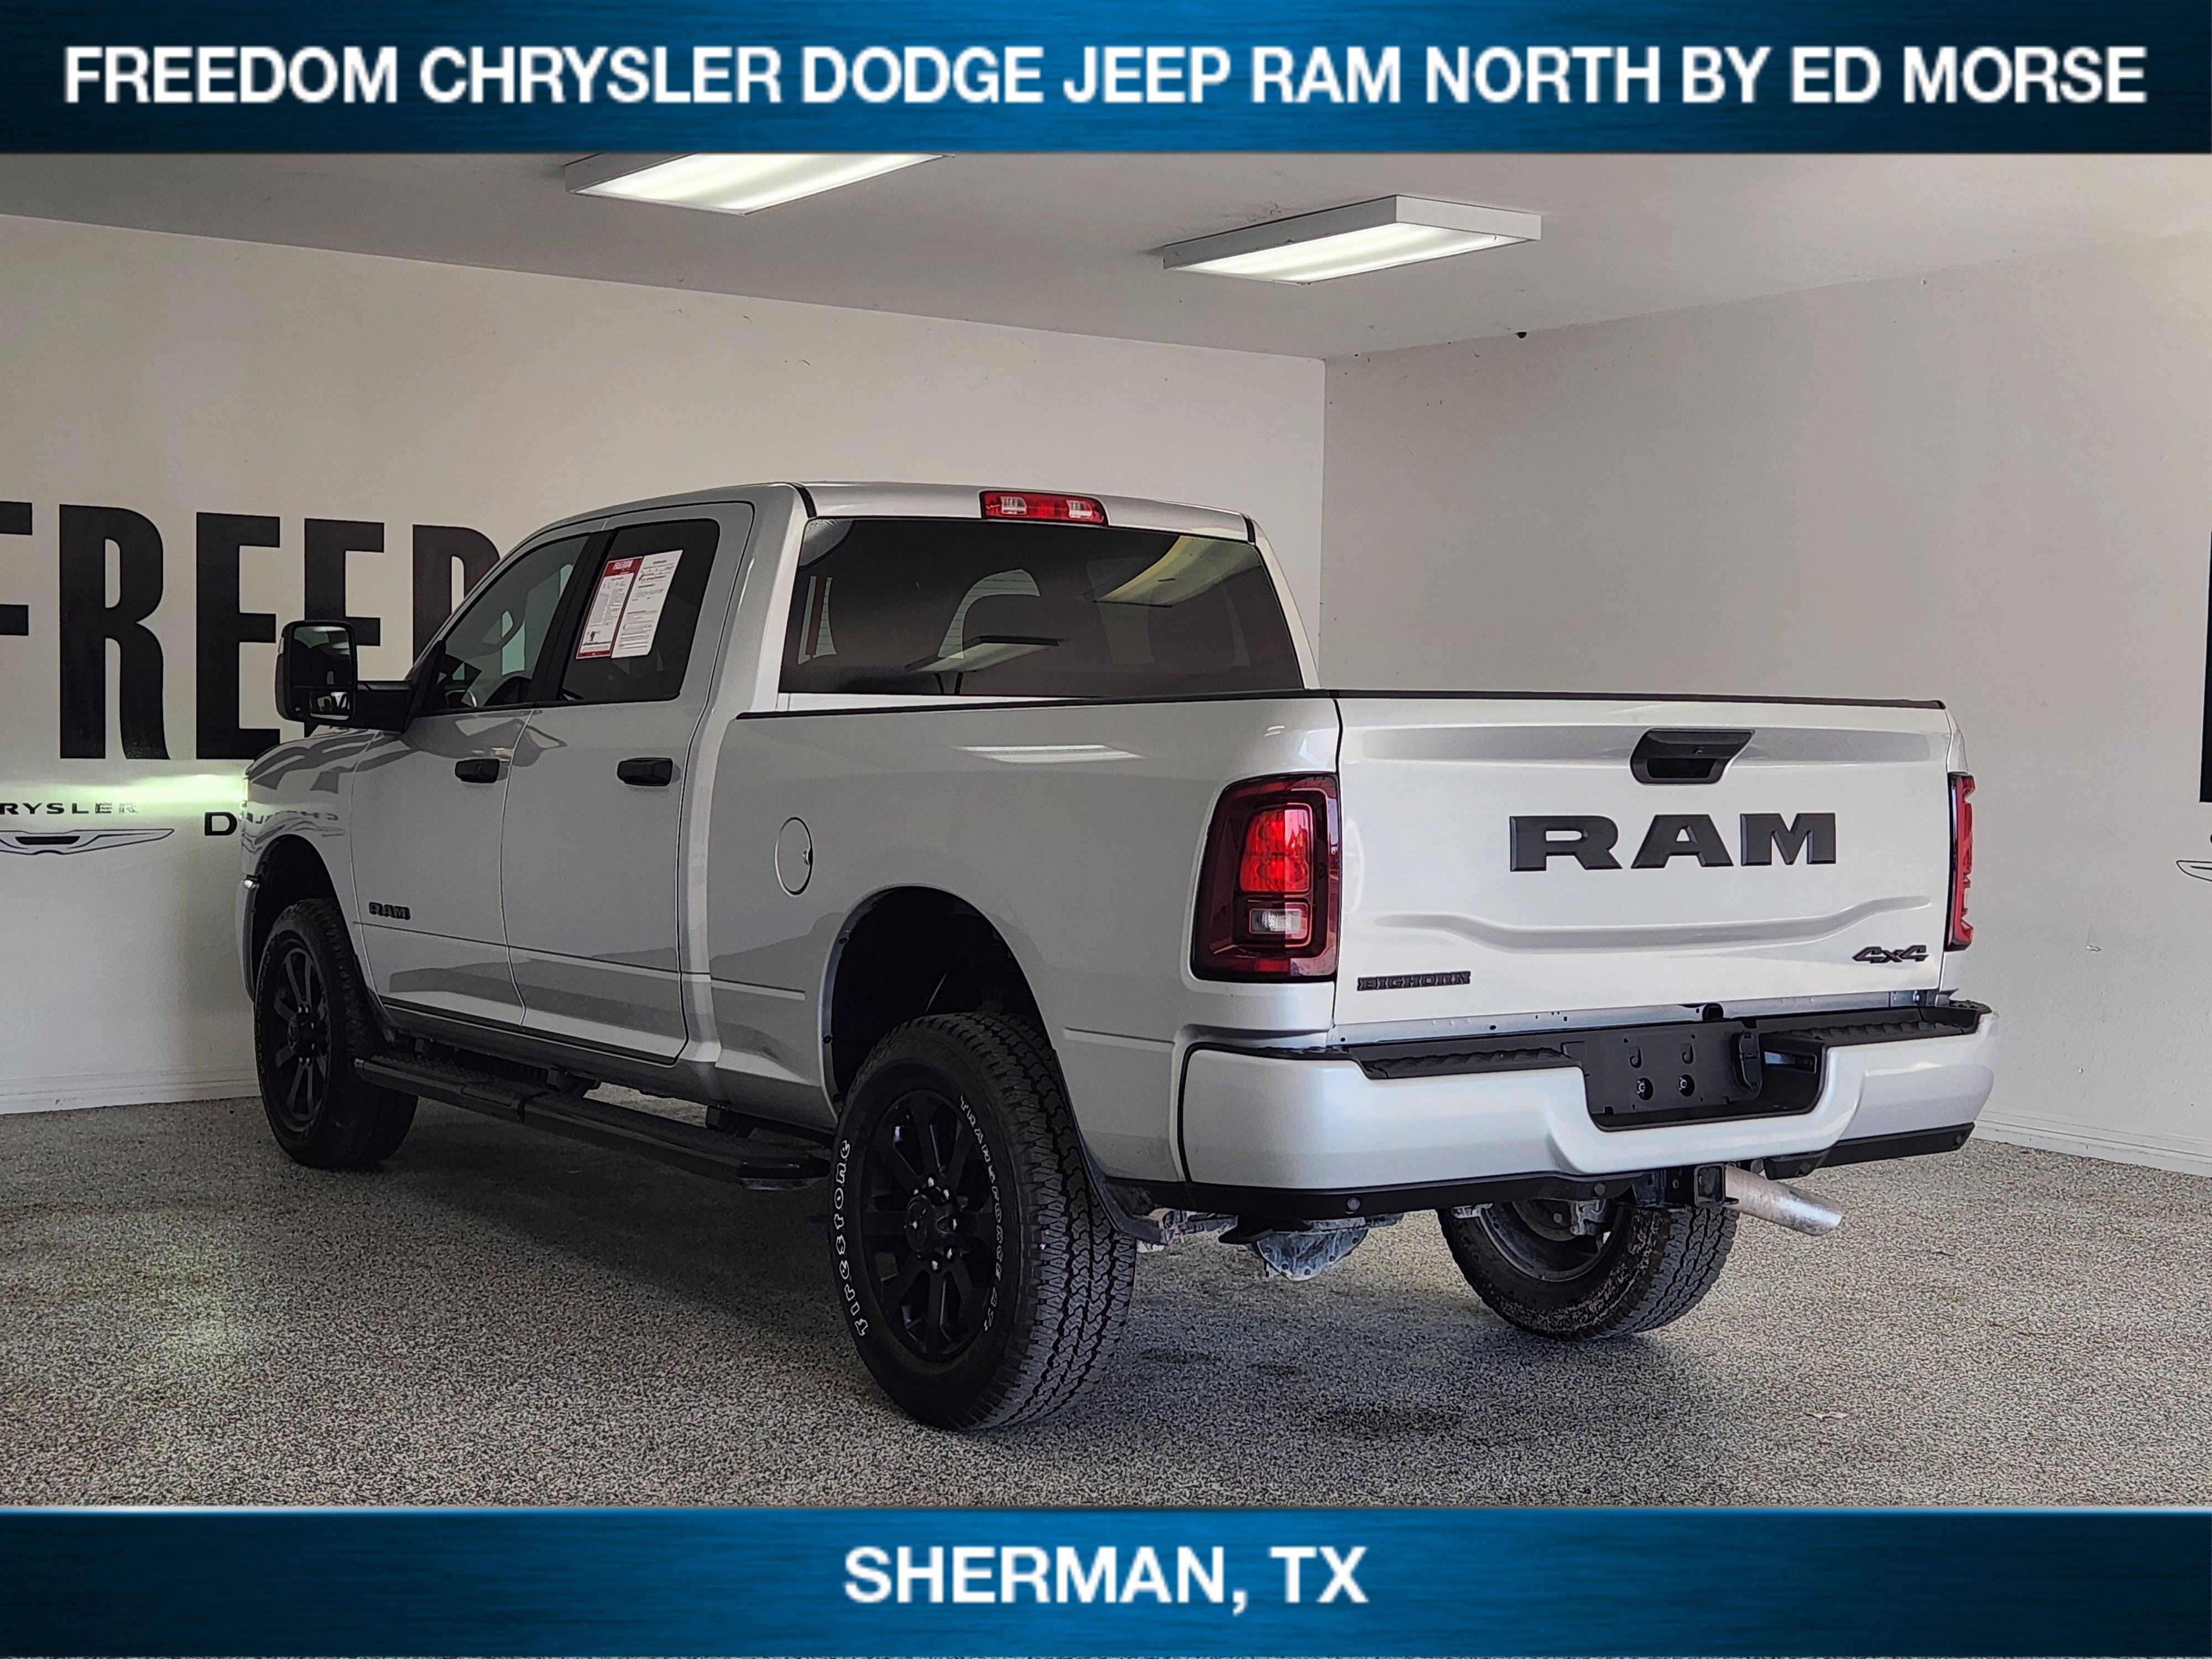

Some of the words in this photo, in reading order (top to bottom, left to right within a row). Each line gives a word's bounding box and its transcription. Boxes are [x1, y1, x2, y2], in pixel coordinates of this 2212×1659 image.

[1509, 812, 1836, 872] RAM
[368, 901, 411, 920] RAM
[1851, 945, 1929, 964] 4x4
[1357, 971, 1471, 991] BIGHORN
